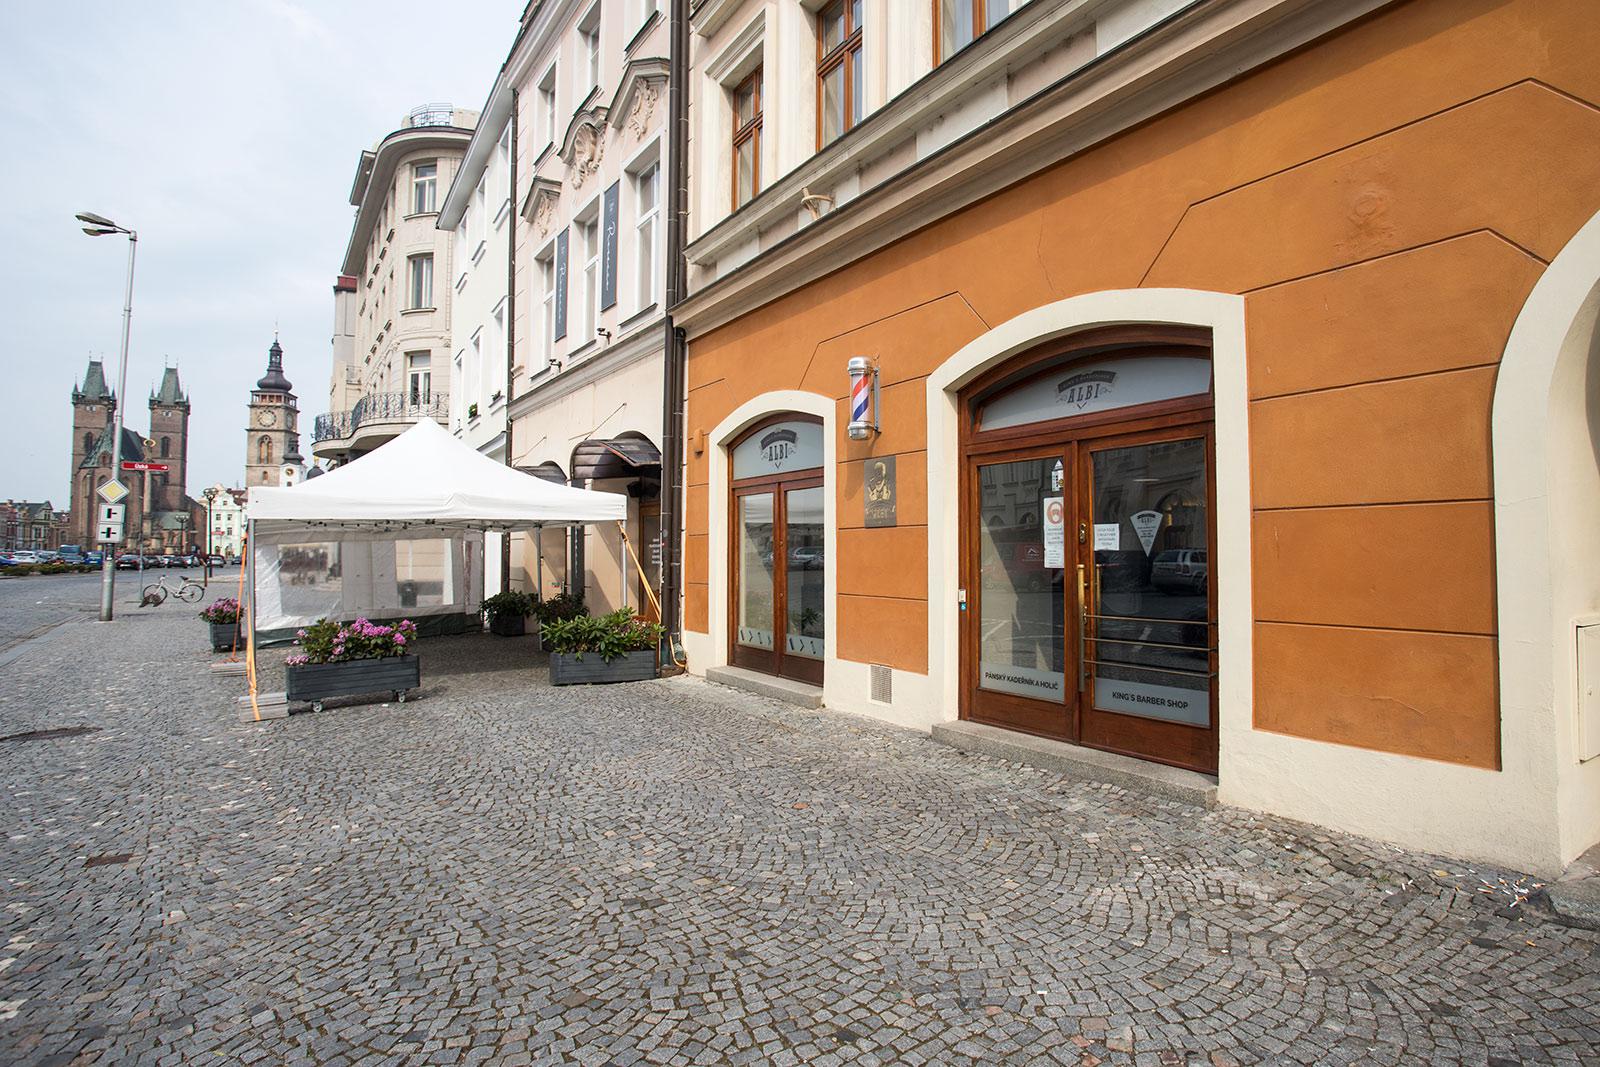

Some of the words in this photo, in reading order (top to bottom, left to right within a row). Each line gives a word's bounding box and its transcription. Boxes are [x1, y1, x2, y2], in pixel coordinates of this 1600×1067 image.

[1067, 383, 1100, 403] ALBI
[768, 443, 788, 461] ALBI
[1136, 694, 1166, 706] BARBER
[1167, 699, 1189, 709] SHOP
